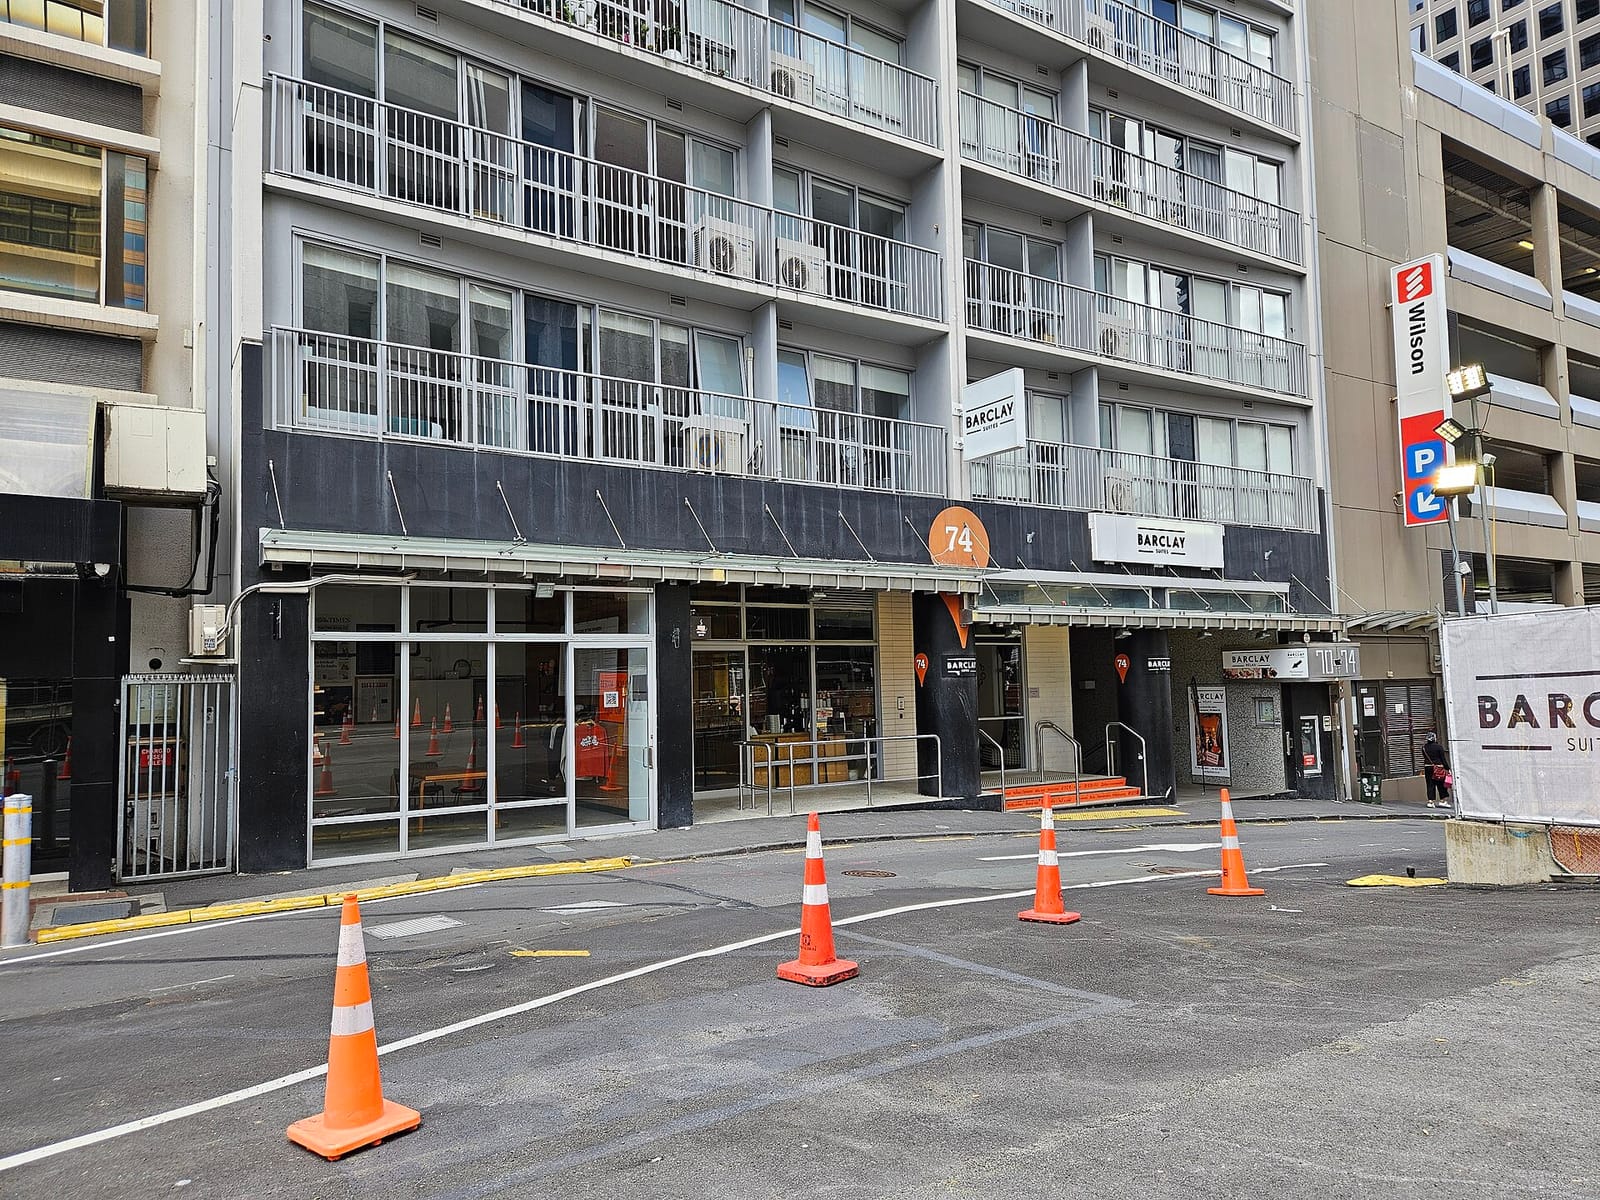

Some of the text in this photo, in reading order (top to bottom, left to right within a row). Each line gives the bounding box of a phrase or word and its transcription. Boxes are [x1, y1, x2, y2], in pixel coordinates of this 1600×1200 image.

[1408, 302, 1426, 375] Wilson
[966, 401, 1014, 429] BARCLAY
[982, 423, 999, 432] SUITES
[1414, 448, 1435, 473] P
[945, 525, 973, 553] 74
[1137, 533, 1186, 549] BARCLAY
[917, 659, 926, 669] 74
[1117, 659, 1128, 668] 74
[1231, 655, 1270, 664] BARCLAY
[1315, 649, 1357, 675] 7074
